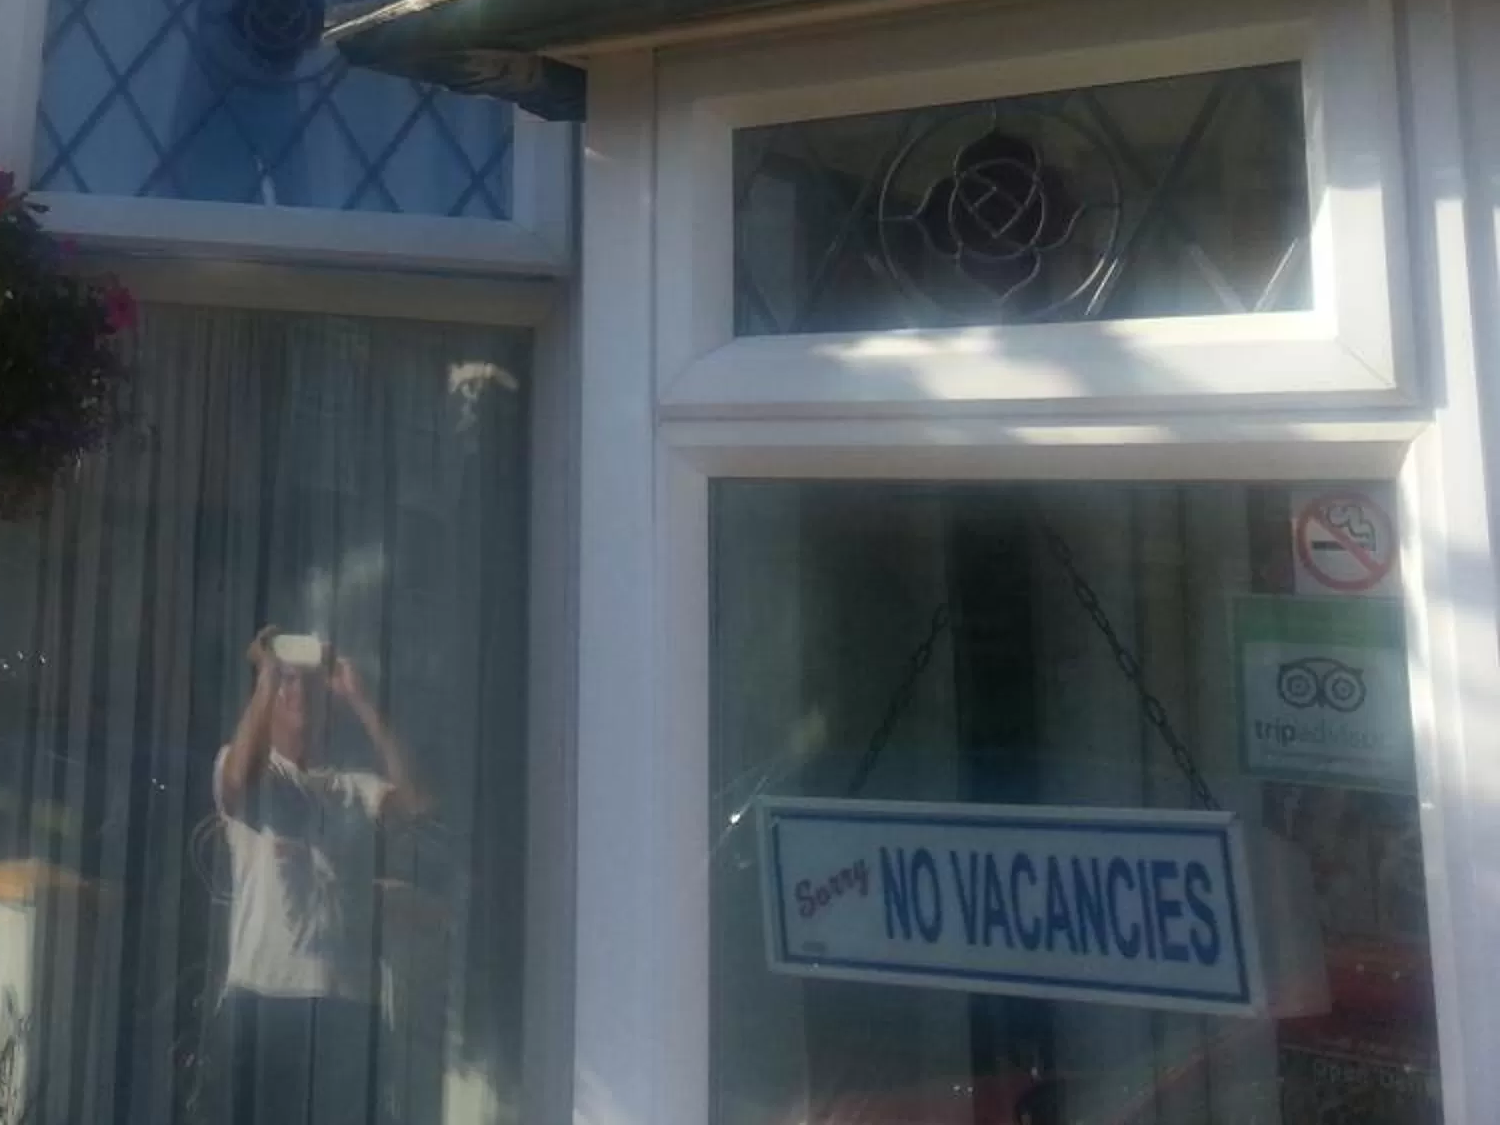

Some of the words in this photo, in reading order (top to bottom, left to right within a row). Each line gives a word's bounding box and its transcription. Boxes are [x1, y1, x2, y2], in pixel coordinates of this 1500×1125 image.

[794, 859, 869, 918] Sorry
[879, 845, 943, 944] NO
[949, 850, 1221, 966] VACANCIES
